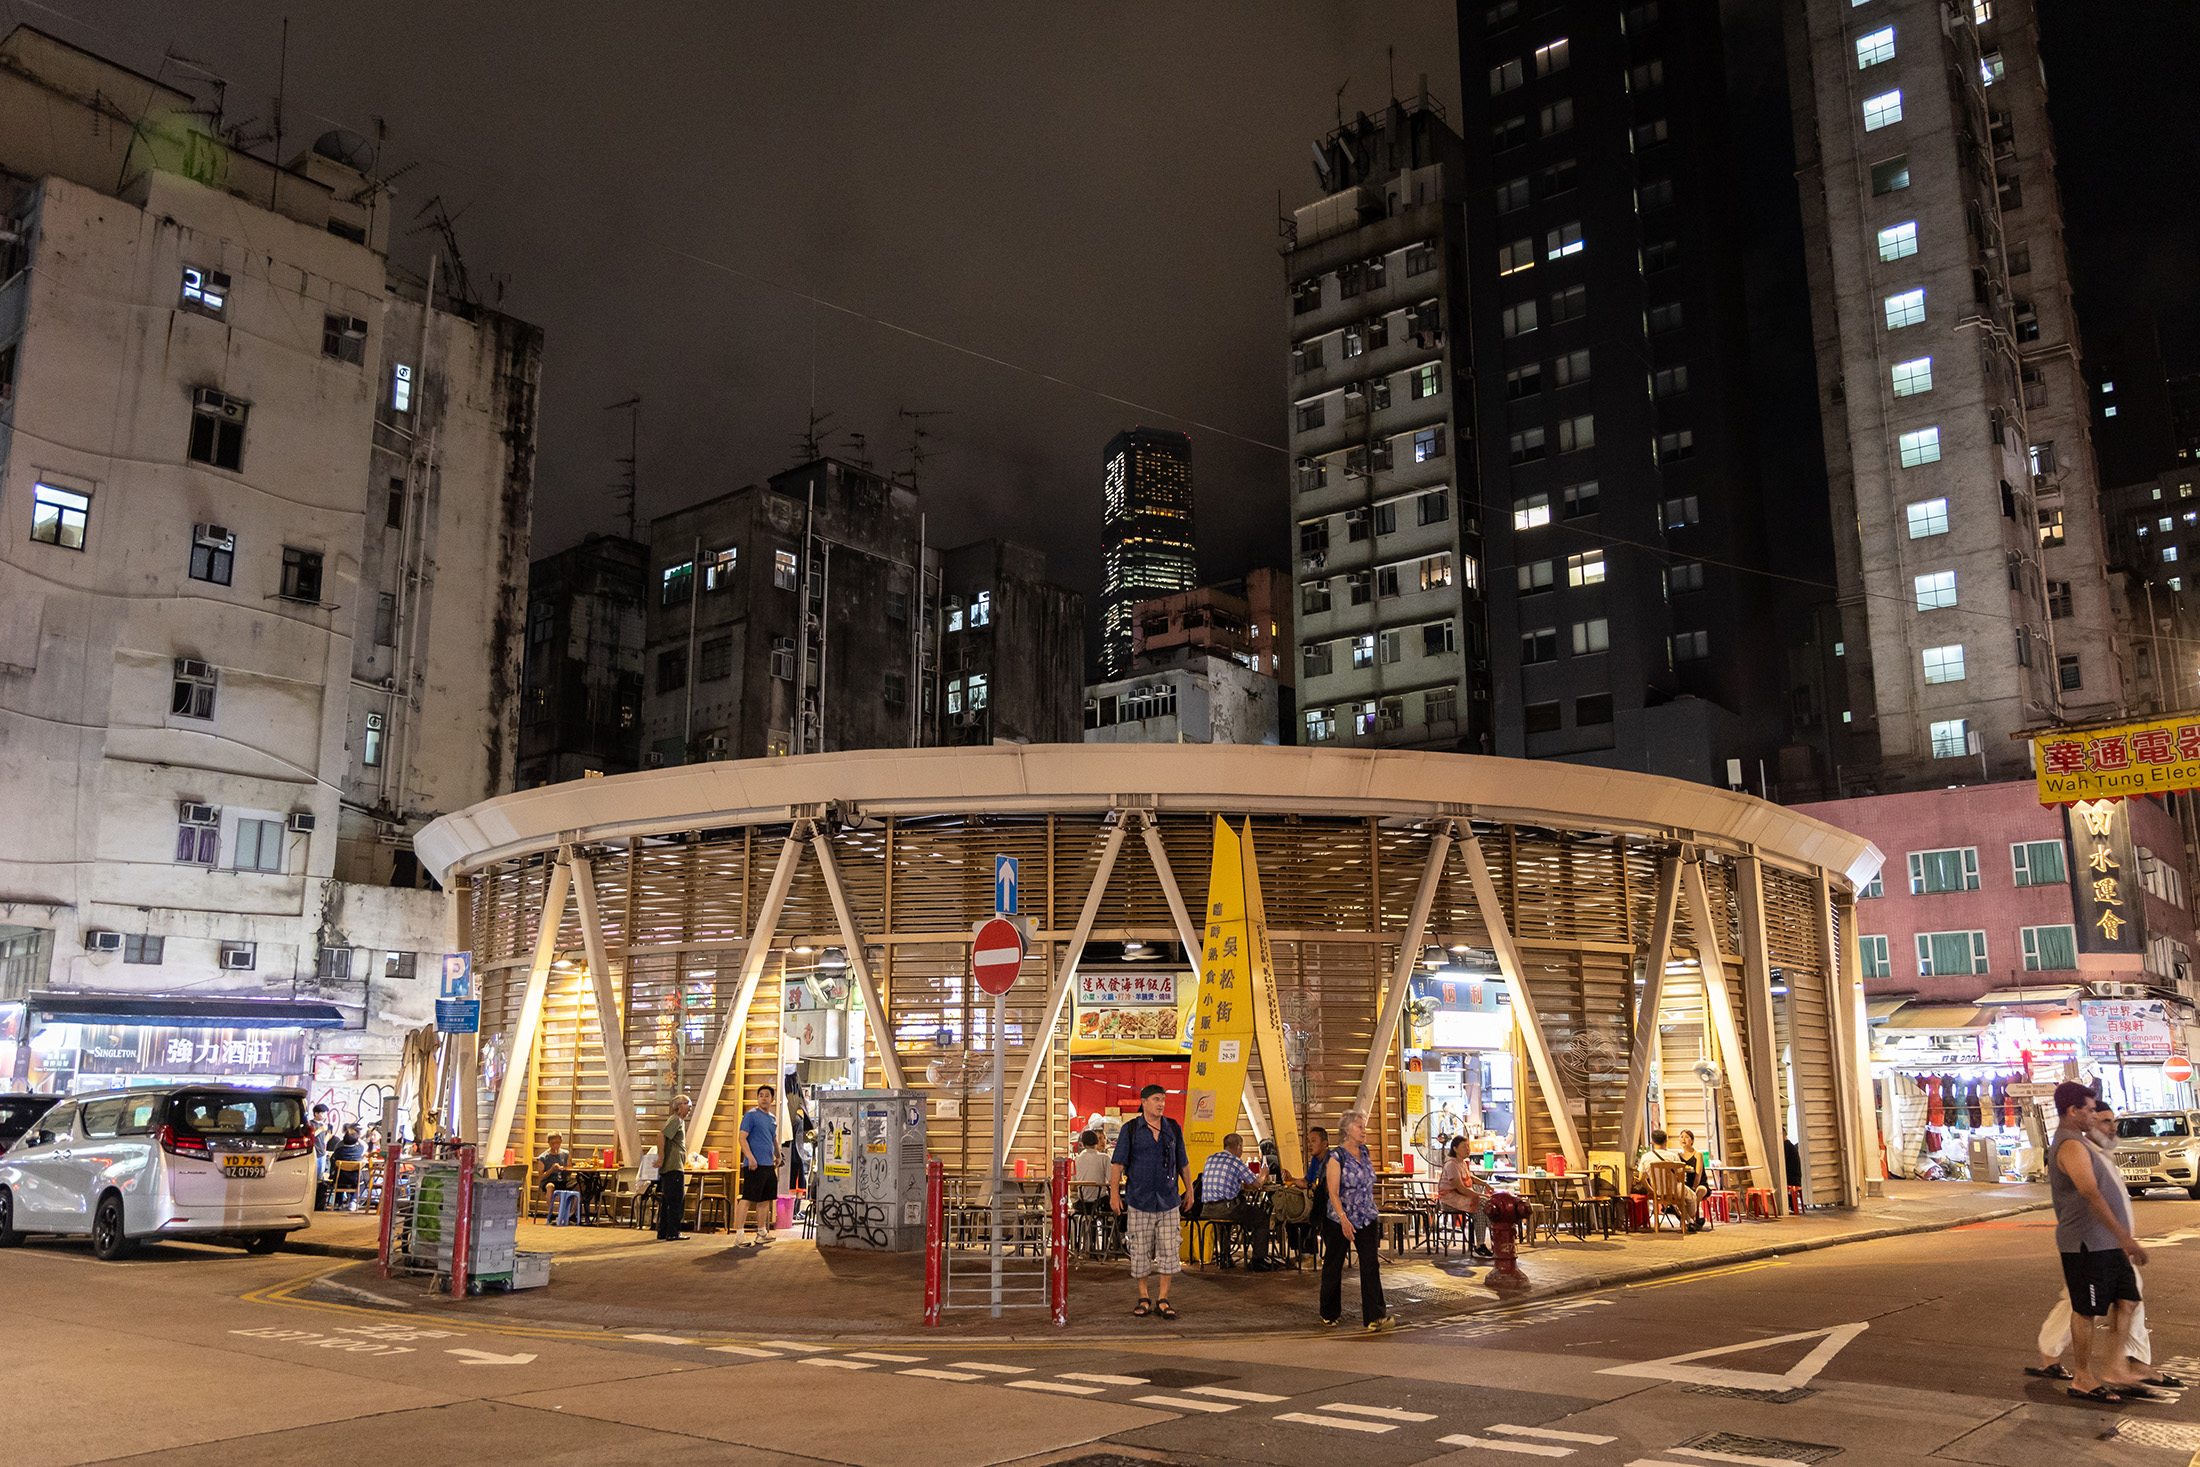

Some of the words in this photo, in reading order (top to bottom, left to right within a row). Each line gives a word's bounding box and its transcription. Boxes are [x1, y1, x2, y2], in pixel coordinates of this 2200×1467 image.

[2046, 777, 2088, 792] Wah
[2095, 773, 2144, 787] Tung
[2152, 766, 2200, 782] Elec
[2089, 844, 2127, 941] 水運會
[446, 958, 465, 993] P
[1216, 936, 1238, 1023] 吳松街
[2087, 1006, 2131, 1016] 電子世界
[167, 1038, 272, 1064] 強力酒莊
[2125, 1034, 2163, 1042] Company
[226, 1156, 239, 1165] YD
[243, 1156, 263, 1165] 799
